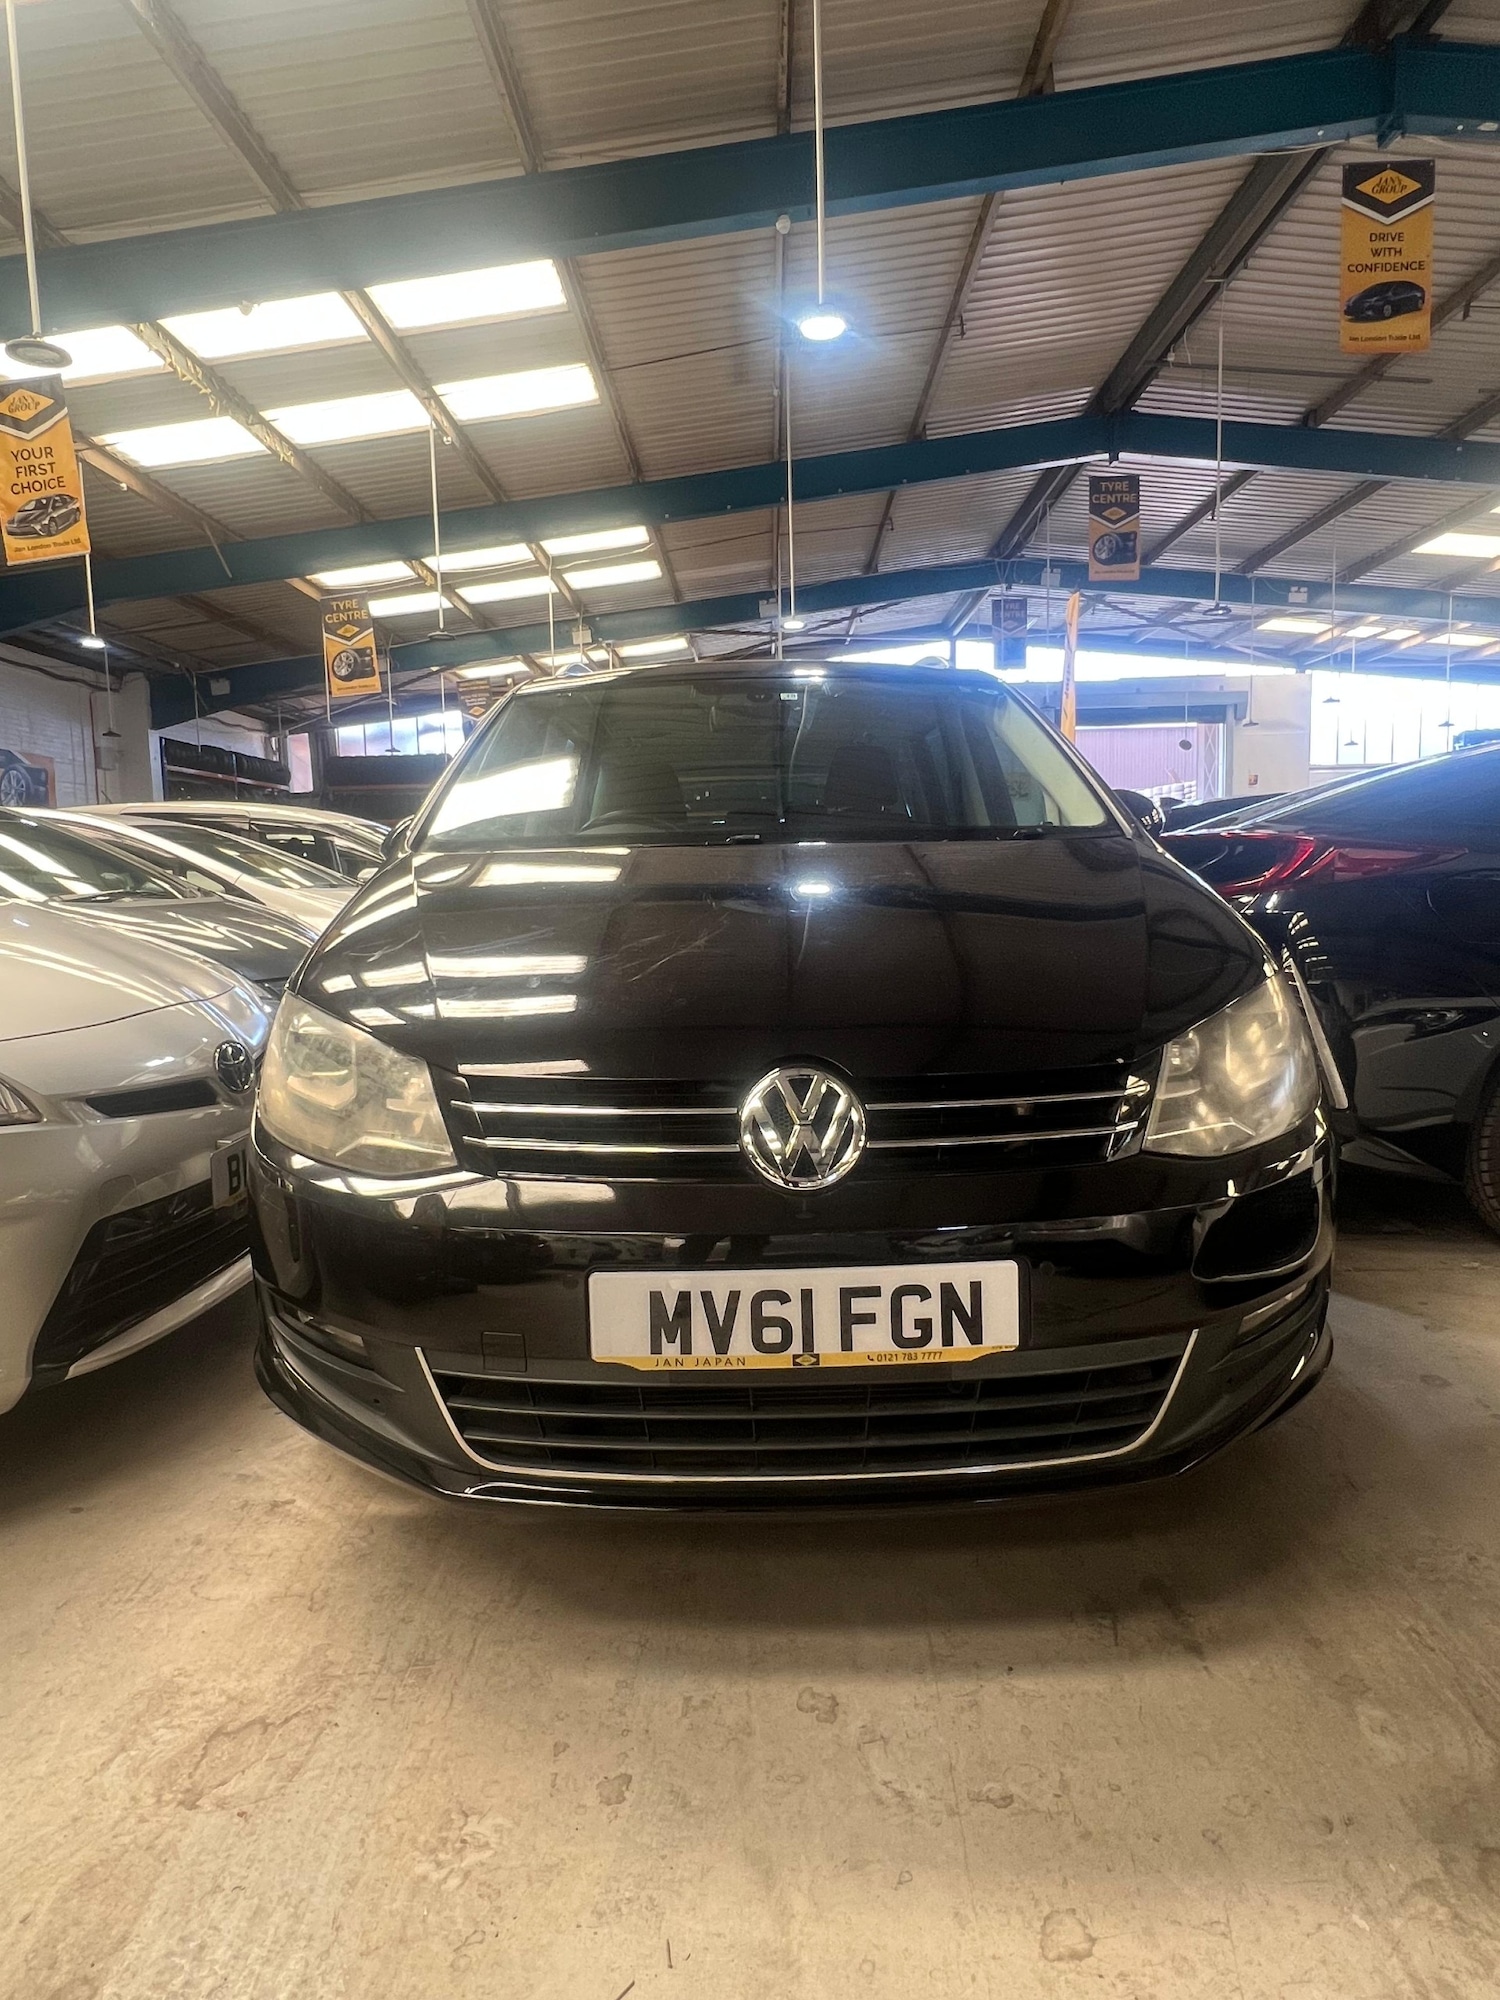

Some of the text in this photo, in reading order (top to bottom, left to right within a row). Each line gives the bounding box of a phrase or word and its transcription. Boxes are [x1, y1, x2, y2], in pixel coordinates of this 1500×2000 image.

[1371, 184, 1407, 194] GROUP
[1369, 232, 1404, 242] DRIVE
[1370, 247, 1402, 258] WITH
[1347, 260, 1425, 273] CONFIDENCE
[8, 401, 40, 413] GROUP
[11, 446, 54, 462] YOUR
[15, 462, 56, 478] FIRST
[10, 476, 66, 495] CHOICE
[1100, 481, 1130, 491] TYRE
[1092, 493, 1137, 504] CENTRE
[331, 599, 359, 611] TYRE
[325, 610, 369, 624] CENTRE
[649, 1280, 983, 1355] MV61 FGN
[654, 1357, 746, 1367] JAN JAPAN
[876, 1351, 942, 1362] 0121 783 7777
